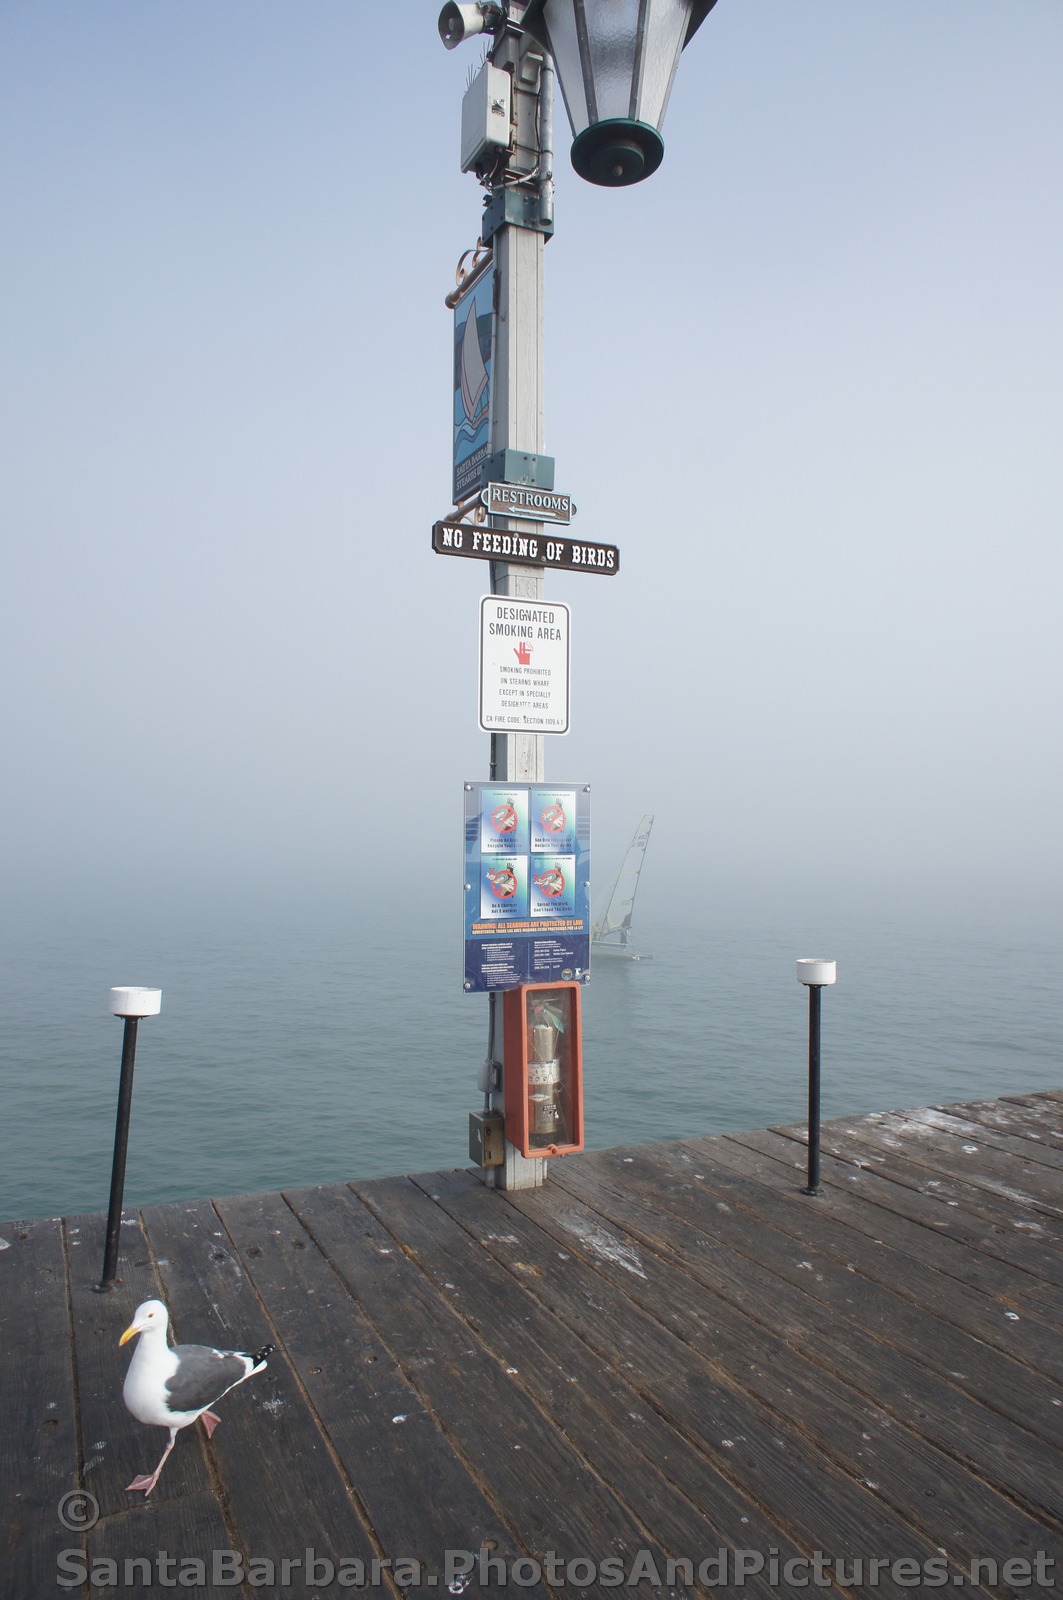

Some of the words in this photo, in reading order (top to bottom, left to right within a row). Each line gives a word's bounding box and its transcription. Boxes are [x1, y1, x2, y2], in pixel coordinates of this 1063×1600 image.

[492, 487, 569, 511] RESTROOMS
[442, 527, 463, 548] NO
[472, 531, 538, 558] FEEDING
[546, 541, 564, 561] OF
[572, 545, 615, 568] BIRDS
[497, 606, 555, 624] DESIGNATED
[489, 622, 533, 638] SMOKING
[537, 627, 562, 641] AREA
[499, 666, 522, 674] SMOKING
[523, 667, 552, 676] PROHIBITED
[501, 677, 508, 685] ON
[508, 678, 531, 686] STEARNS
[533, 679, 550, 687] WHARF
